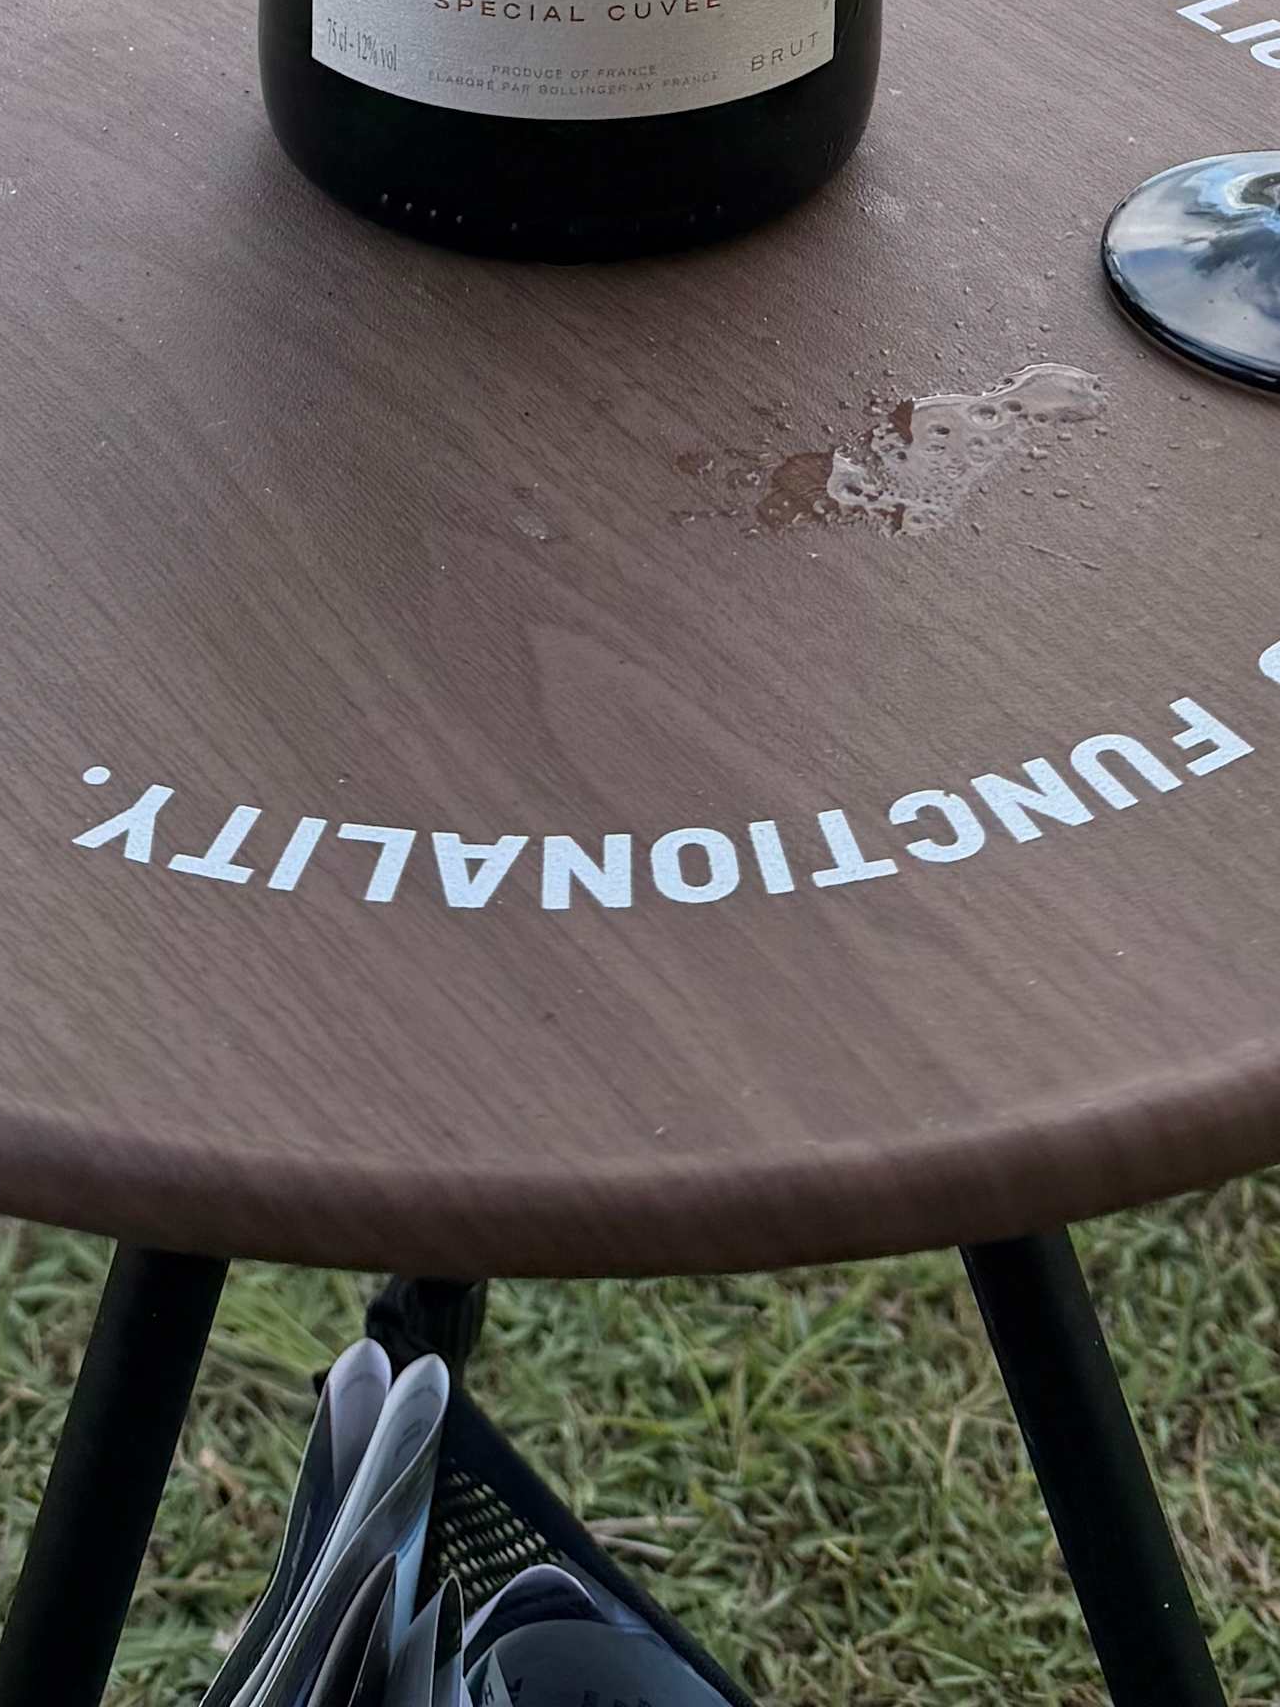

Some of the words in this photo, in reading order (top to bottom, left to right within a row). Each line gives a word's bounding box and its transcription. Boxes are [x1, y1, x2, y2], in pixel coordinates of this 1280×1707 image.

[380, 43, 397, 72] vol
[751, 31, 819, 73] BRUT
[491, 64, 563, 80] PRODUCE
[570, 68, 591, 80] OF
[597, 65, 657, 79] FRANCE
[70, 697, 1256, 911] FUNCTIONALITY.
